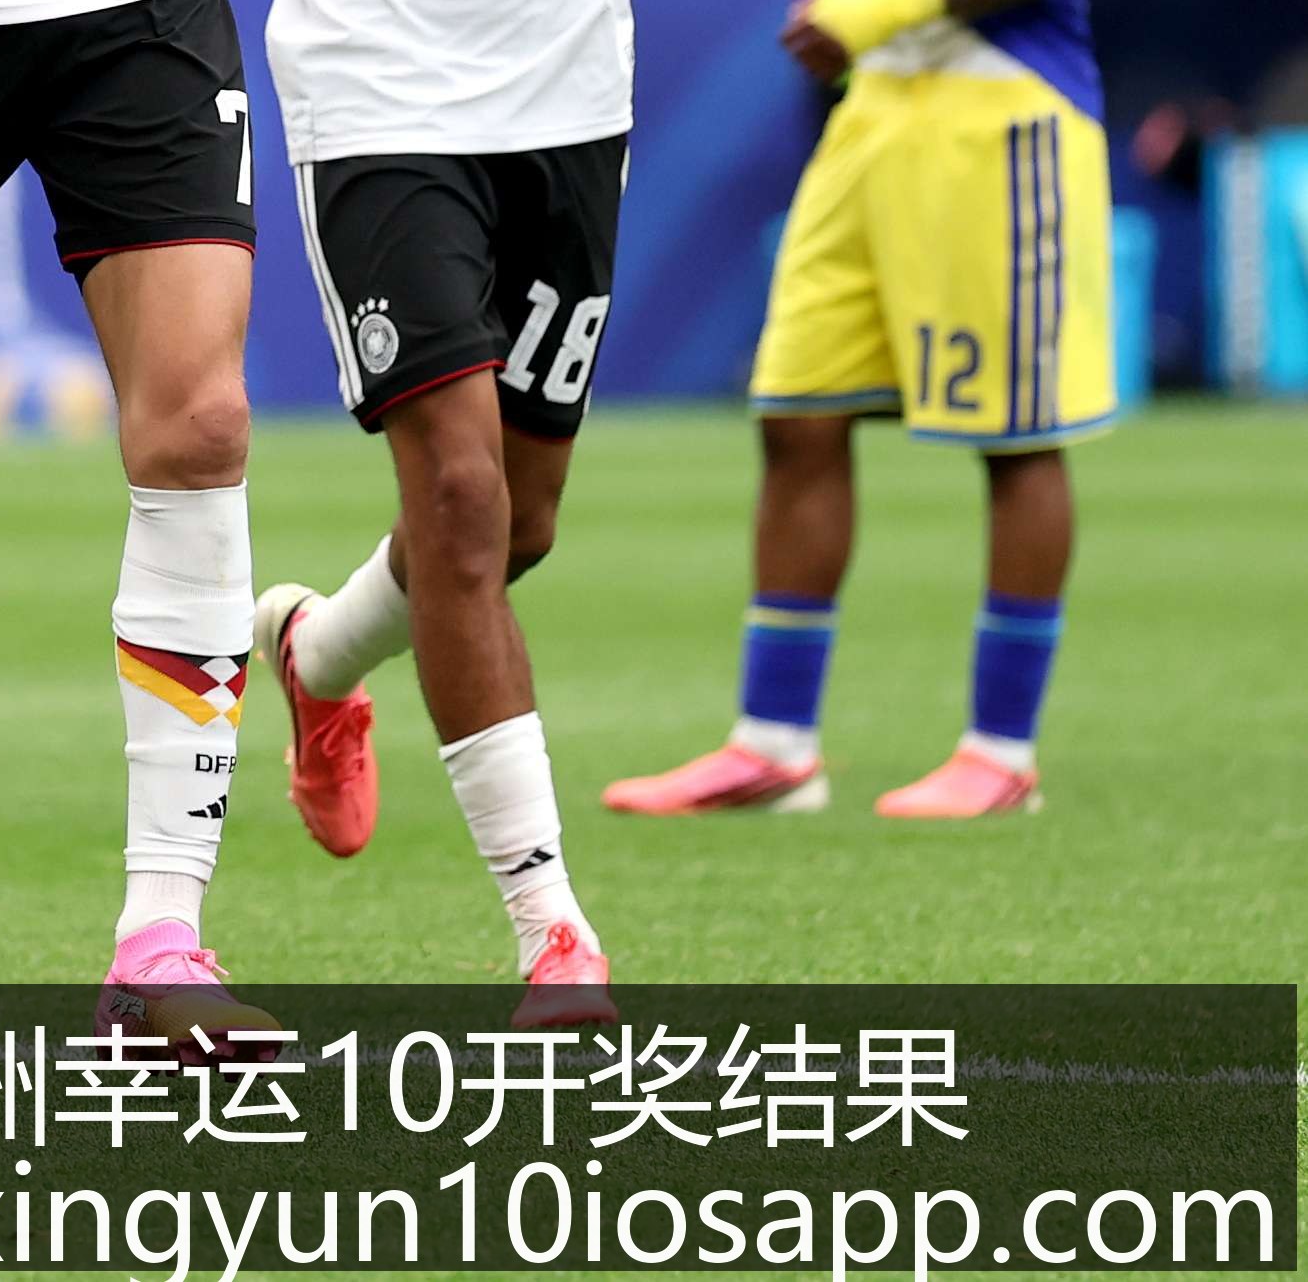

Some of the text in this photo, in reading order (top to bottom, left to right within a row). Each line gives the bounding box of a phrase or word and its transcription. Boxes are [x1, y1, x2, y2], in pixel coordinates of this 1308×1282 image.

[214, 88, 251, 206] 7
[498, 278, 611, 405] 18
[918, 325, 981, 411] 12
